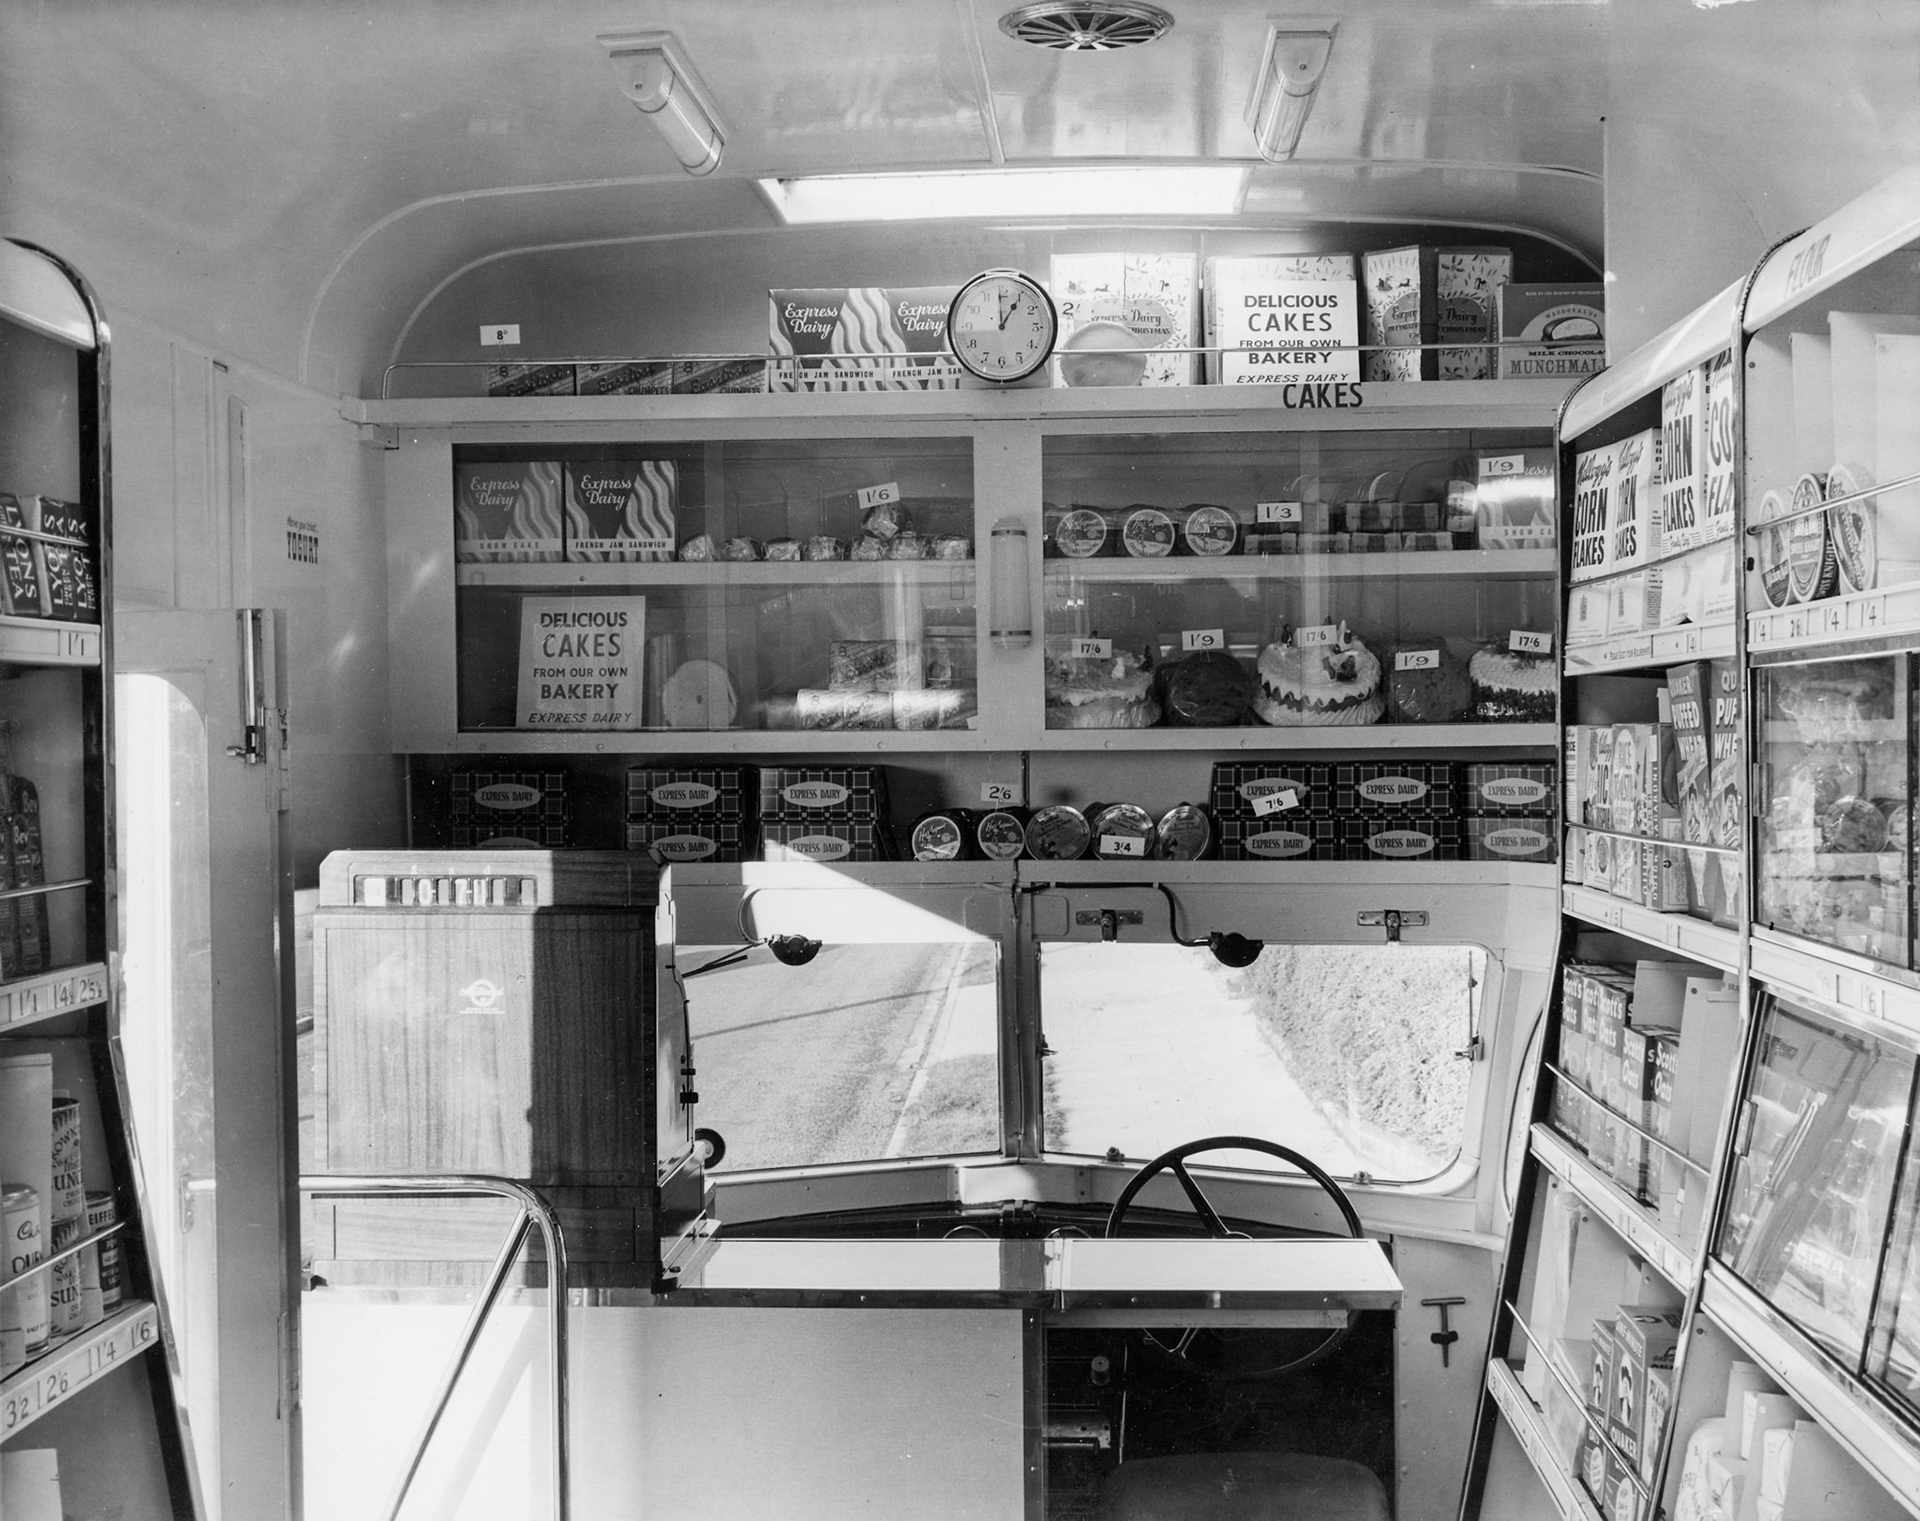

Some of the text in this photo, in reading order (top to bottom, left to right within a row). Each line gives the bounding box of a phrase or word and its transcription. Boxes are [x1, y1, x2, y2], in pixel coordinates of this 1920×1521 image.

[1244, 295, 1339, 308] DELICIOUS
[784, 302, 839, 321] Express
[897, 301, 950, 319] Express
[1027, 305, 1035, 316] 2
[1445, 305, 1478, 326] Dairy
[1130, 308, 1162, 327] Dairy
[1248, 312, 1333, 332] CAKES
[789, 320, 834, 340] Dairy
[902, 317, 948, 337] Dairy
[1031, 322, 1040, 333] 3
[969, 339, 977, 349] 8
[1026, 339, 1034, 350] 4
[1239, 339, 1342, 348] FROM OUR OWN
[982, 351, 990, 362] 7
[997, 356, 1006, 367] 6
[1014, 351, 1023, 362] 5
[1248, 351, 1333, 365] BAKERY
[778, 370, 874, 380] FRECH JAM SANDWICH
[892, 368, 943, 379] FRENCH JAM
[1236, 373, 1349, 384] EXPRESS DAIRY
[1282, 382, 1364, 409] CAKES
[1710, 395, 1732, 467] CO
[1662, 414, 1693, 486] CORN
[1577, 453, 1613, 489] Kellogg's
[469, 475, 521, 493] Express
[580, 474, 632, 493] Express
[474, 491, 515, 512] Dairy
[585, 490, 626, 511] Dairy
[1574, 486, 1609, 539] CORN
[1663, 485, 1696, 534] FLAKES
[1504, 529, 1534, 537] SNOW
[286, 530, 319, 565] YOGURT
[513, 541, 540, 549] CAKE
[575, 541, 667, 550] FRENCH JAM SANDWICH
[1572, 534, 1606, 570] FLAKES
[540, 611, 628, 629] DELICIOUS
[542, 632, 622, 659] CAKES
[533, 666, 628, 678] FROM OUR OWN
[1721, 670, 1737, 693] QU
[540, 682, 620, 700] BAKERY
[527, 712, 632, 724] EXPRESS DAIRY
[1715, 697, 1738, 727] PUF
[658, 789, 710, 801] EXPRESS DAIRY
[789, 788, 842, 800] EXPRESS DAIRY
[1246, 784, 1275, 795] EXPRESS
[1366, 783, 1419, 795] EXPRESS DAIRY
[1488, 785, 1540, 797] EXPRESS DAIRY
[481, 791, 534, 802] EXPRESS DAIRY
[12, 825, 29, 845] Bev
[1490, 835, 1542, 847] EXPRESS DAIRY
[658, 842, 709, 853] EXPRESS DAIRY
[793, 842, 844, 854] EXPRESS DAIRY
[1251, 838, 1305, 849] EXPRESS DAIRY
[1374, 836, 1428, 849] EXPRESS DAIRY
[1653, 1070, 1673, 1104] Oats
[88, 1209, 115, 1226] EIFFEL
